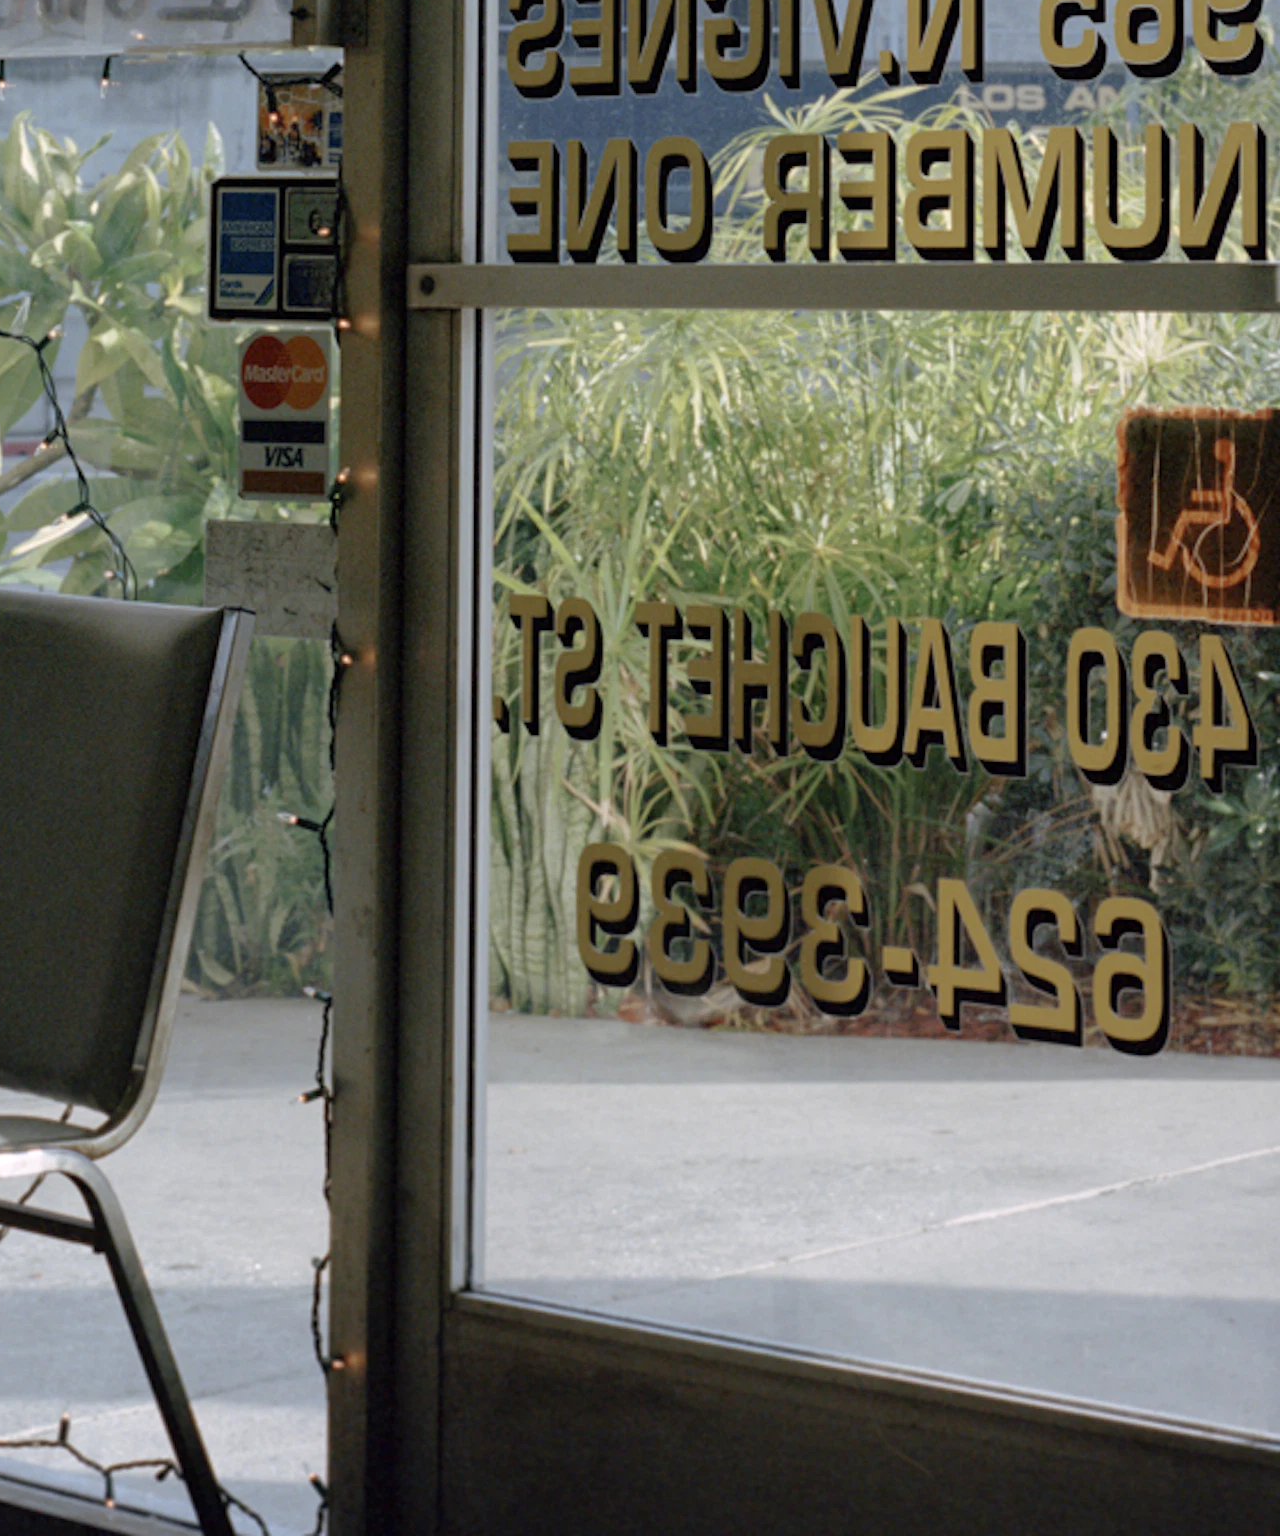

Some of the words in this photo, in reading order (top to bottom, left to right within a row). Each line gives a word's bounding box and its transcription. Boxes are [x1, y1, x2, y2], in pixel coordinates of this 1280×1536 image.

[958, 84, 1046, 112] LOS
[243, 362, 325, 384] MasterCard
[264, 446, 304, 468] VISA
